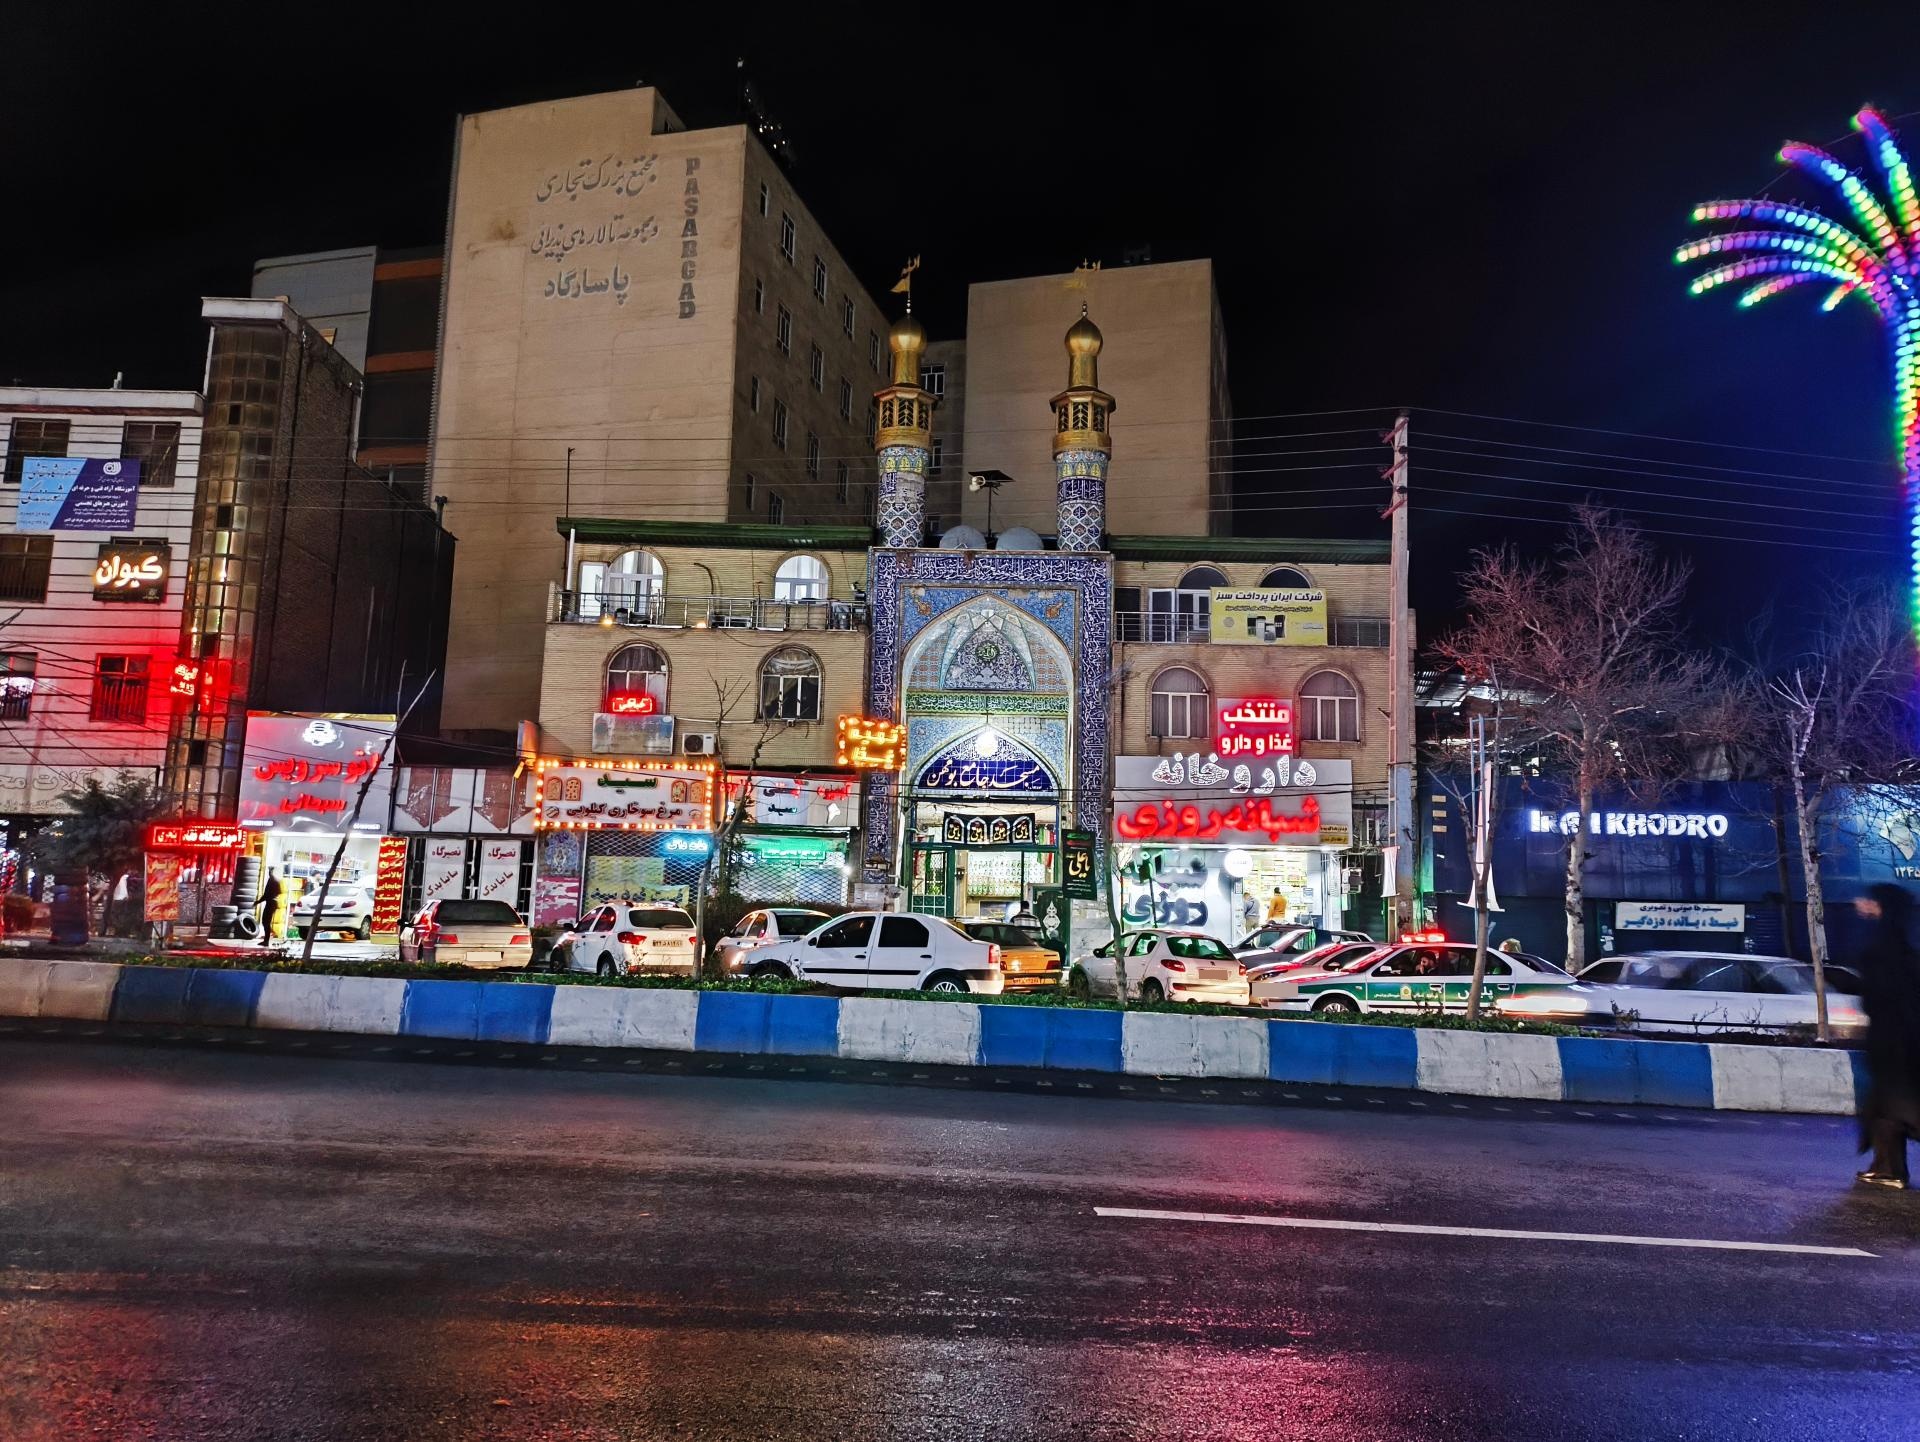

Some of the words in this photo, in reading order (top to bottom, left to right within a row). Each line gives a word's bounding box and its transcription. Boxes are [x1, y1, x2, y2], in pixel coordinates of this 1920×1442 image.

[536, 158, 593, 202] تجاری
[625, 153, 658, 196] مجتمع
[618, 214, 655, 244] مجموعه
[678, 157, 700, 319] PASARGAD
[544, 263, 630, 305] پاسارگاد
[96, 555, 163, 588] کیوان
[1216, 591, 1233, 601] سبز
[1235, 591, 1269, 604] پرداخت
[1270, 592, 1293, 602] ایران
[1294, 591, 1323, 602] شرکت
[1222, 701, 1291, 729] منتخب
[1221, 736, 1251, 754] دارو
[1256, 738, 1265, 755] و
[1266, 733, 1293, 751] غذا
[254, 757, 342, 784] سرویس
[926, 759, 958, 787] بومهن
[960, 762, 990, 789] جامع
[991, 764, 1040, 789] مسجد
[1151, 752, 1317, 794] داروخانه
[597, 773, 659, 794] سید
[566, 801, 608, 819] کیلویی
[607, 801, 656, 819] سوخاری
[656, 801, 682, 818] مرغ
[1606, 812, 1729, 839] KHODRO
[378, 870, 402, 880] بالانس
[374, 904, 400, 913] پنچری
[1121, 890, 1209, 927] روزی
[1672, 905, 1692, 913] صوتی
